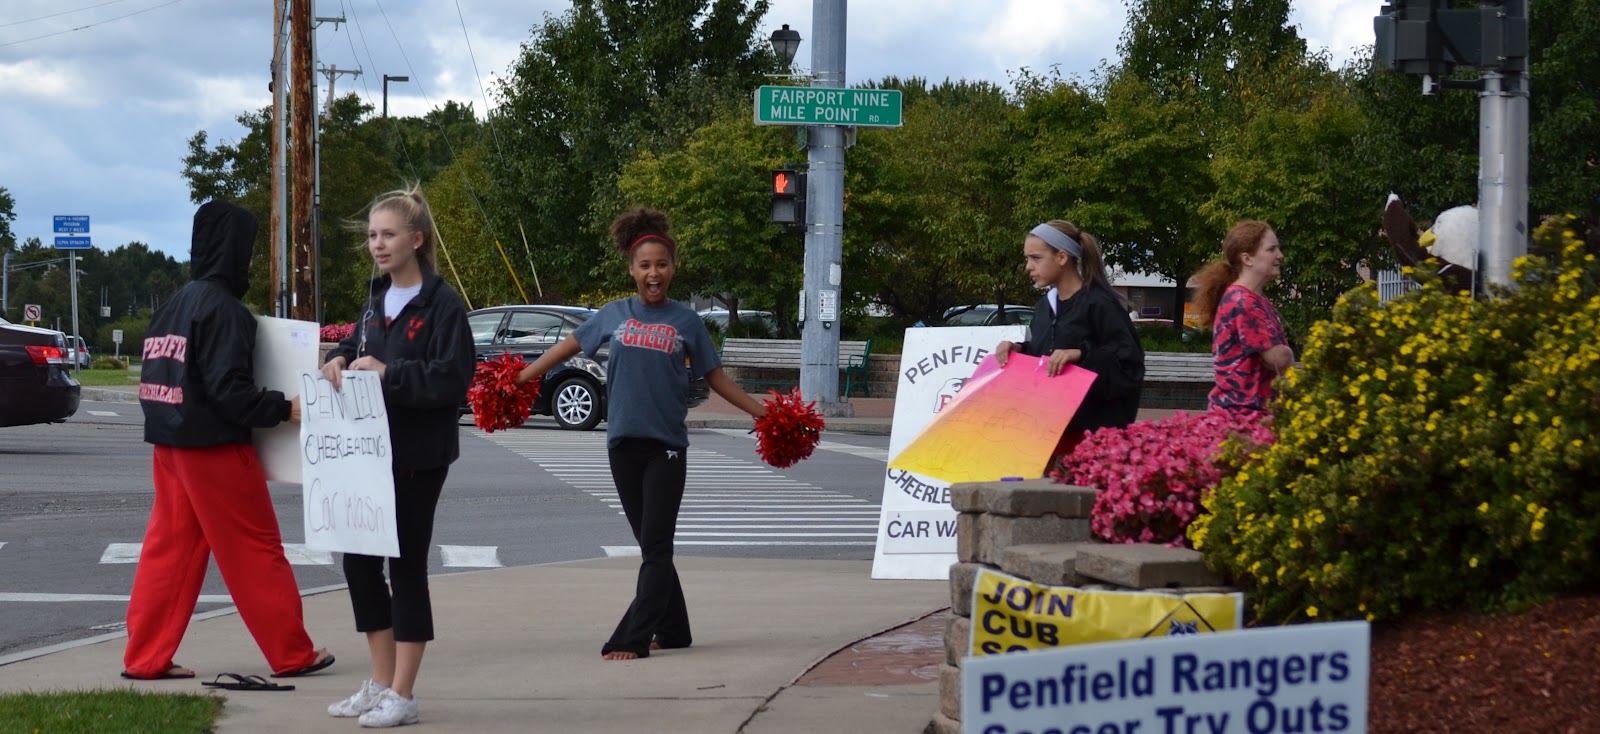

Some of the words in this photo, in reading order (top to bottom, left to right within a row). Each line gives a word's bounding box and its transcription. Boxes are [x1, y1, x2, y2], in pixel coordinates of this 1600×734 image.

[770, 105, 806, 120] MILE
[815, 106, 859, 122] POINT
[869, 114, 880, 123] RD
[771, 89, 845, 106] FAIRPORT
[853, 92, 889, 107] NINE
[622, 319, 677, 354] CHEER
[303, 373, 385, 421] PENIELD
[305, 434, 386, 465] CHEERLEADING
[308, 477, 338, 532] Car
[887, 520, 930, 539] CAR
[983, 582, 1075, 618] JOIN
[983, 609, 1059, 647] CUB
[981, 656, 1155, 713] Penfield
[1172, 649, 1350, 697] Rangers
[1246, 697, 1350, 734] Outs
